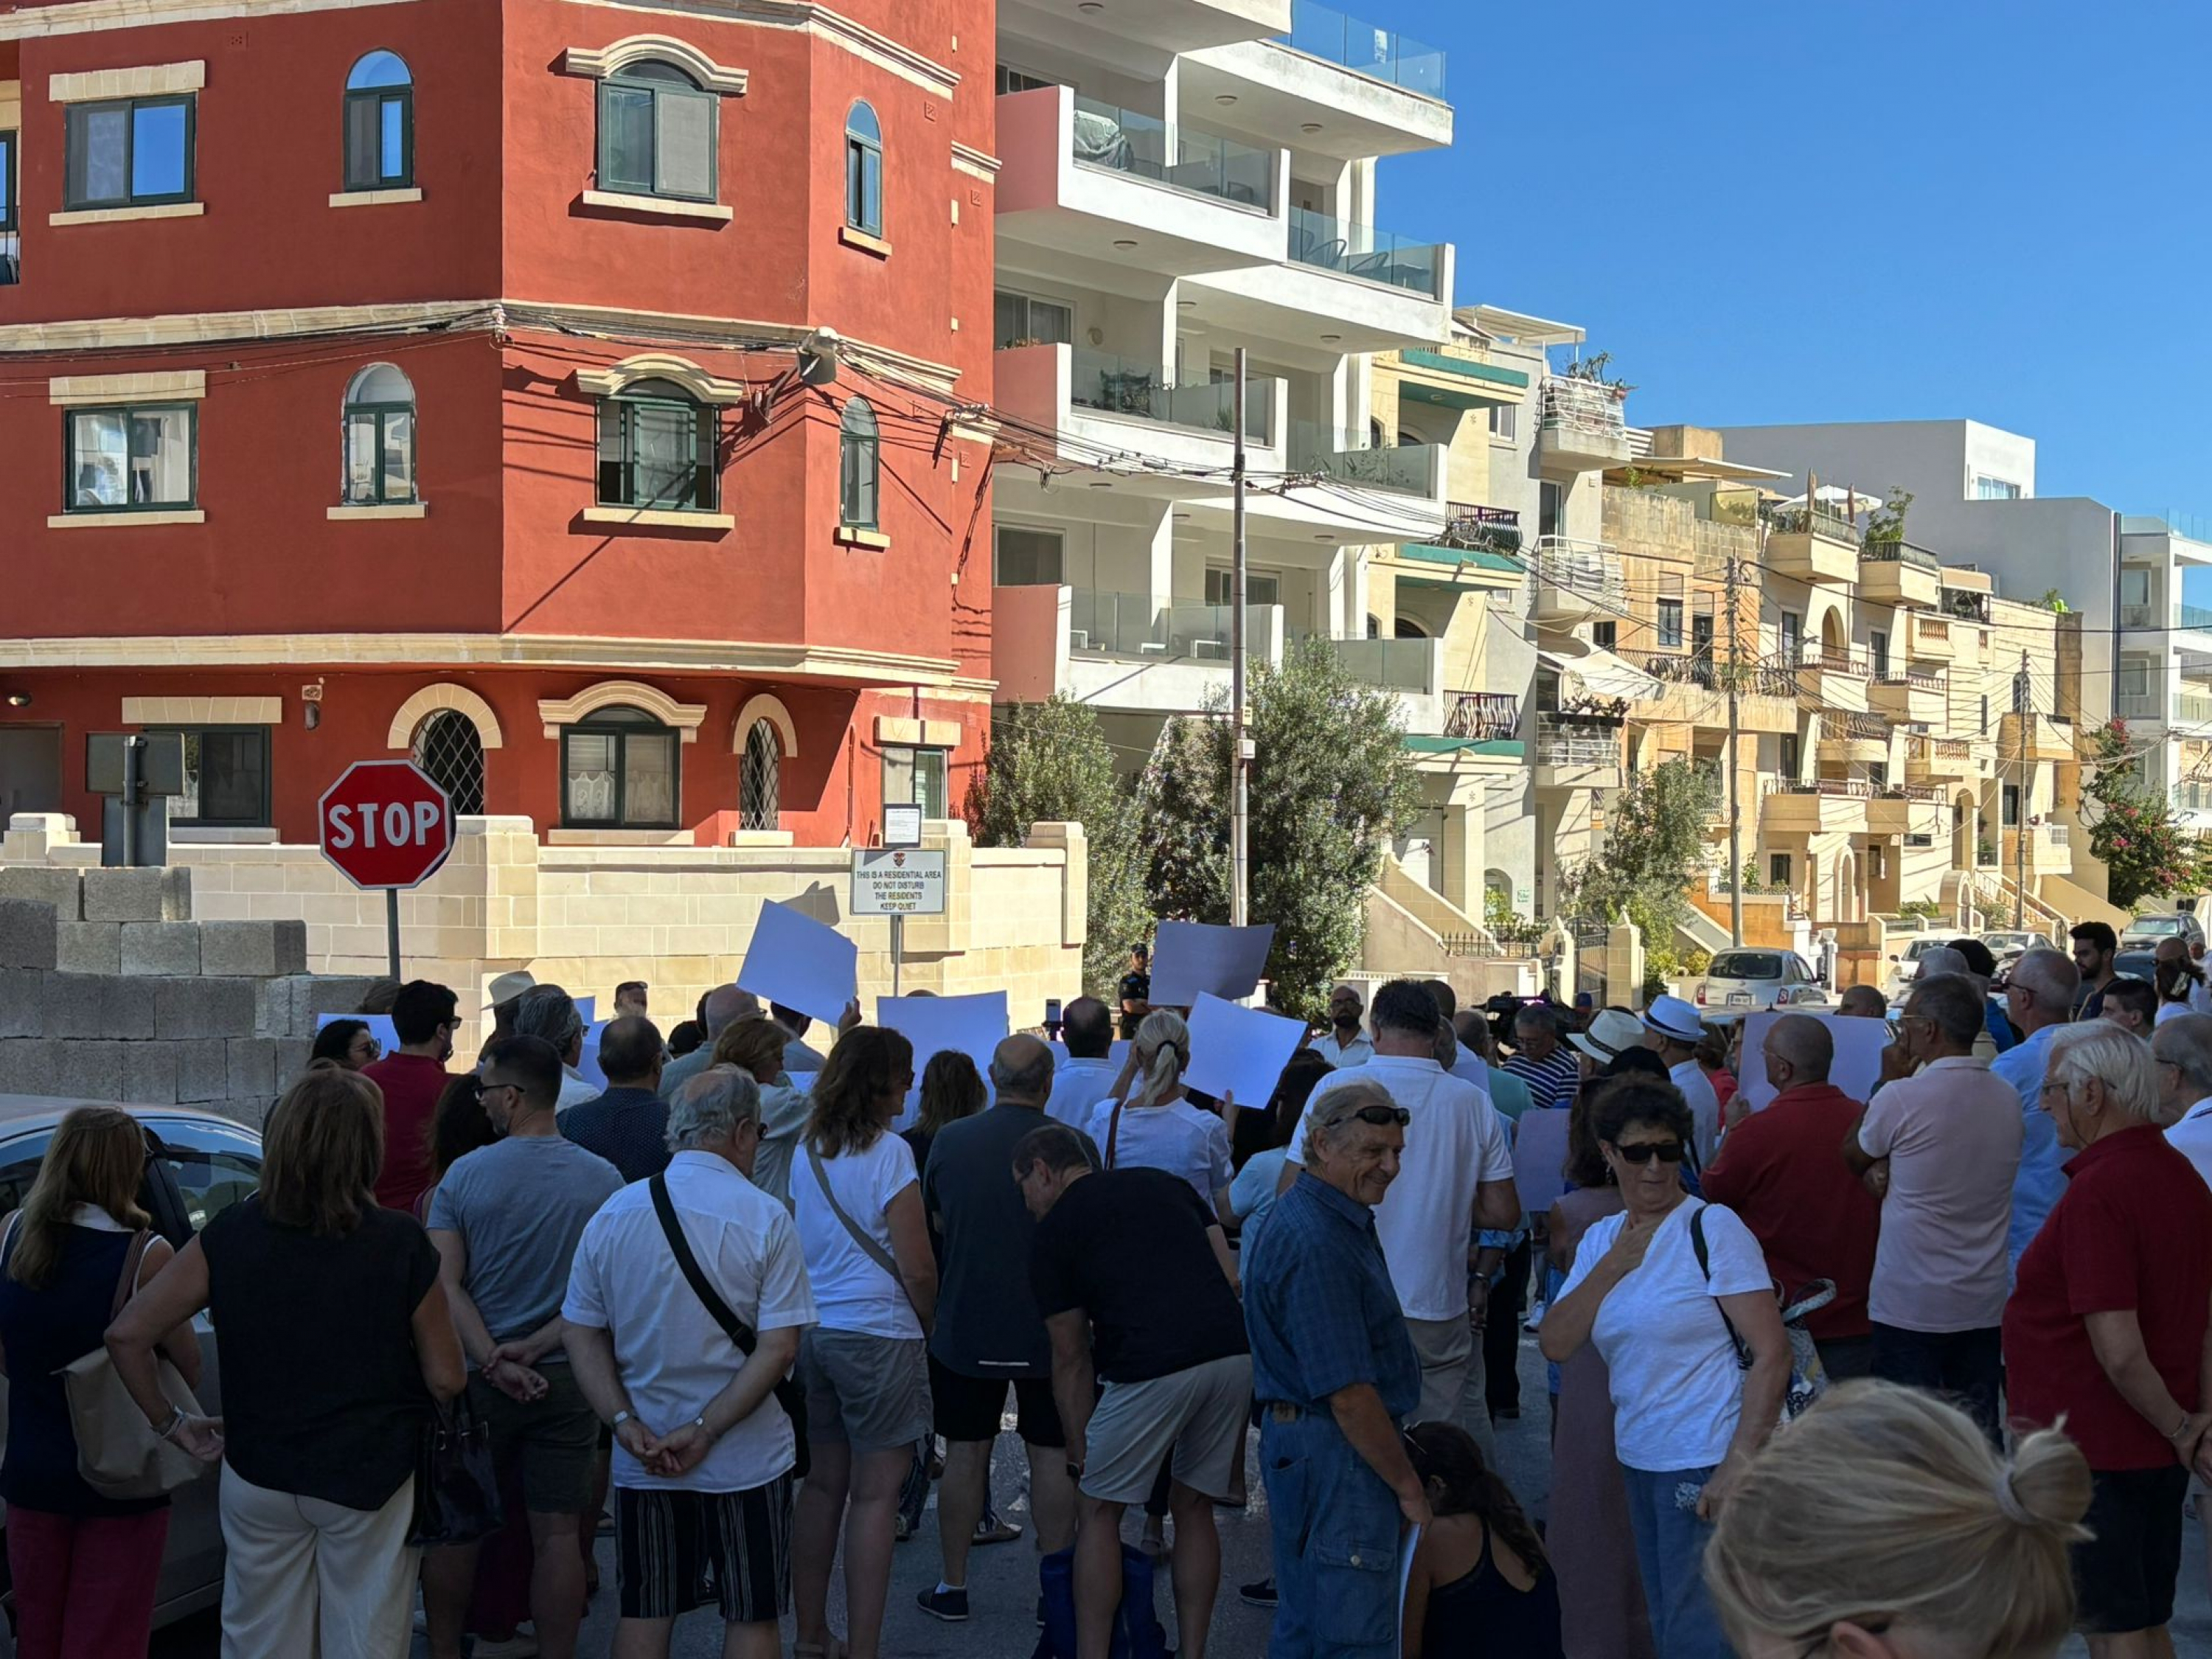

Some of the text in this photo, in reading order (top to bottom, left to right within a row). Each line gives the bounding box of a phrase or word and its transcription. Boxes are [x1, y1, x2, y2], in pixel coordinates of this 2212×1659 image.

[329, 801, 439, 848] STOP
[872, 881, 925, 889] DO NOT DISTURB
